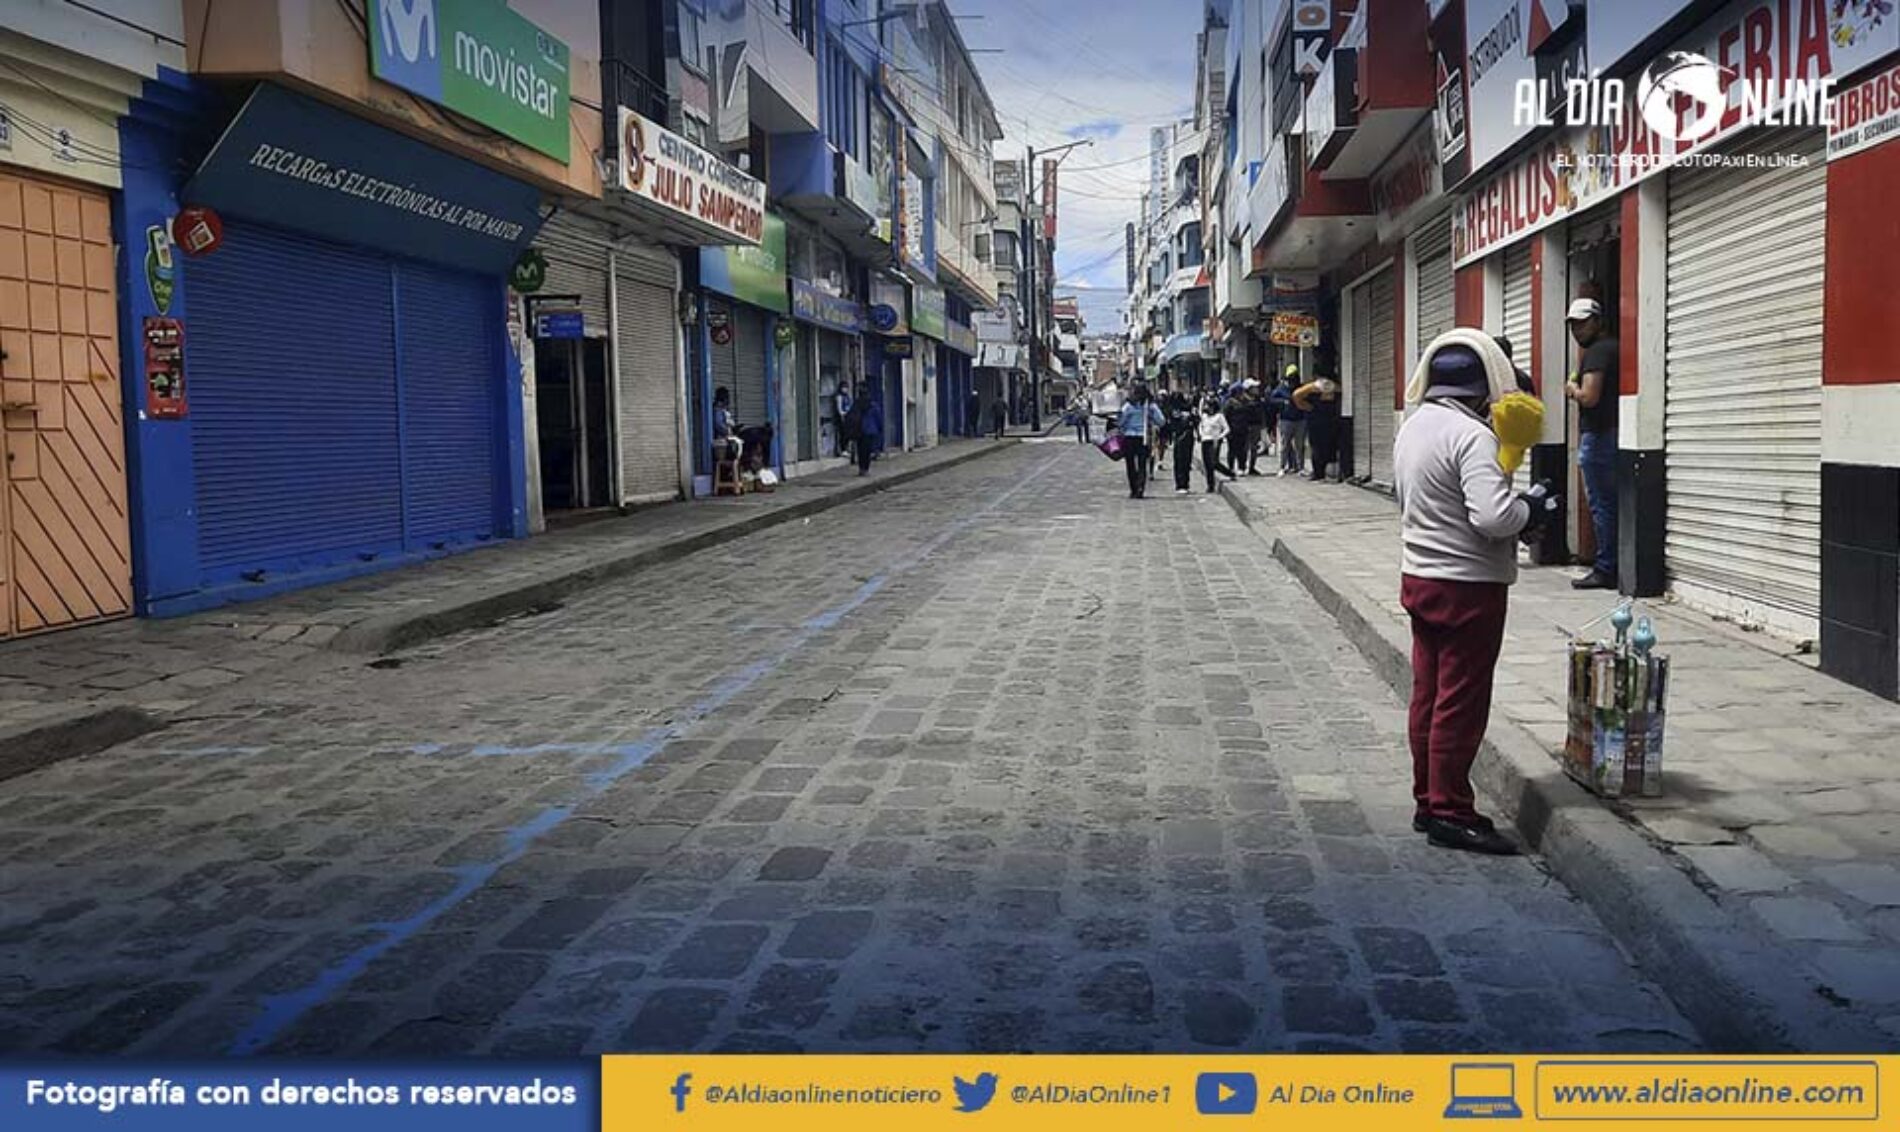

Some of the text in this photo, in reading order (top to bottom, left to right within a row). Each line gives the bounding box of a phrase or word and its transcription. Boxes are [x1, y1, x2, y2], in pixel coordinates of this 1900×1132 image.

[455, 30, 558, 120] movistar
[659, 131, 705, 175] CENTRO
[340, 172, 449, 219] ELECTRÓNICAS
[441, 204, 463, 224] AL
[459, 209, 488, 231] POR
[482, 216, 524, 241] MAYOR
[651, 163, 763, 242] JULIO SAMPEDRO
[1465, 141, 1557, 255] REGALOS
